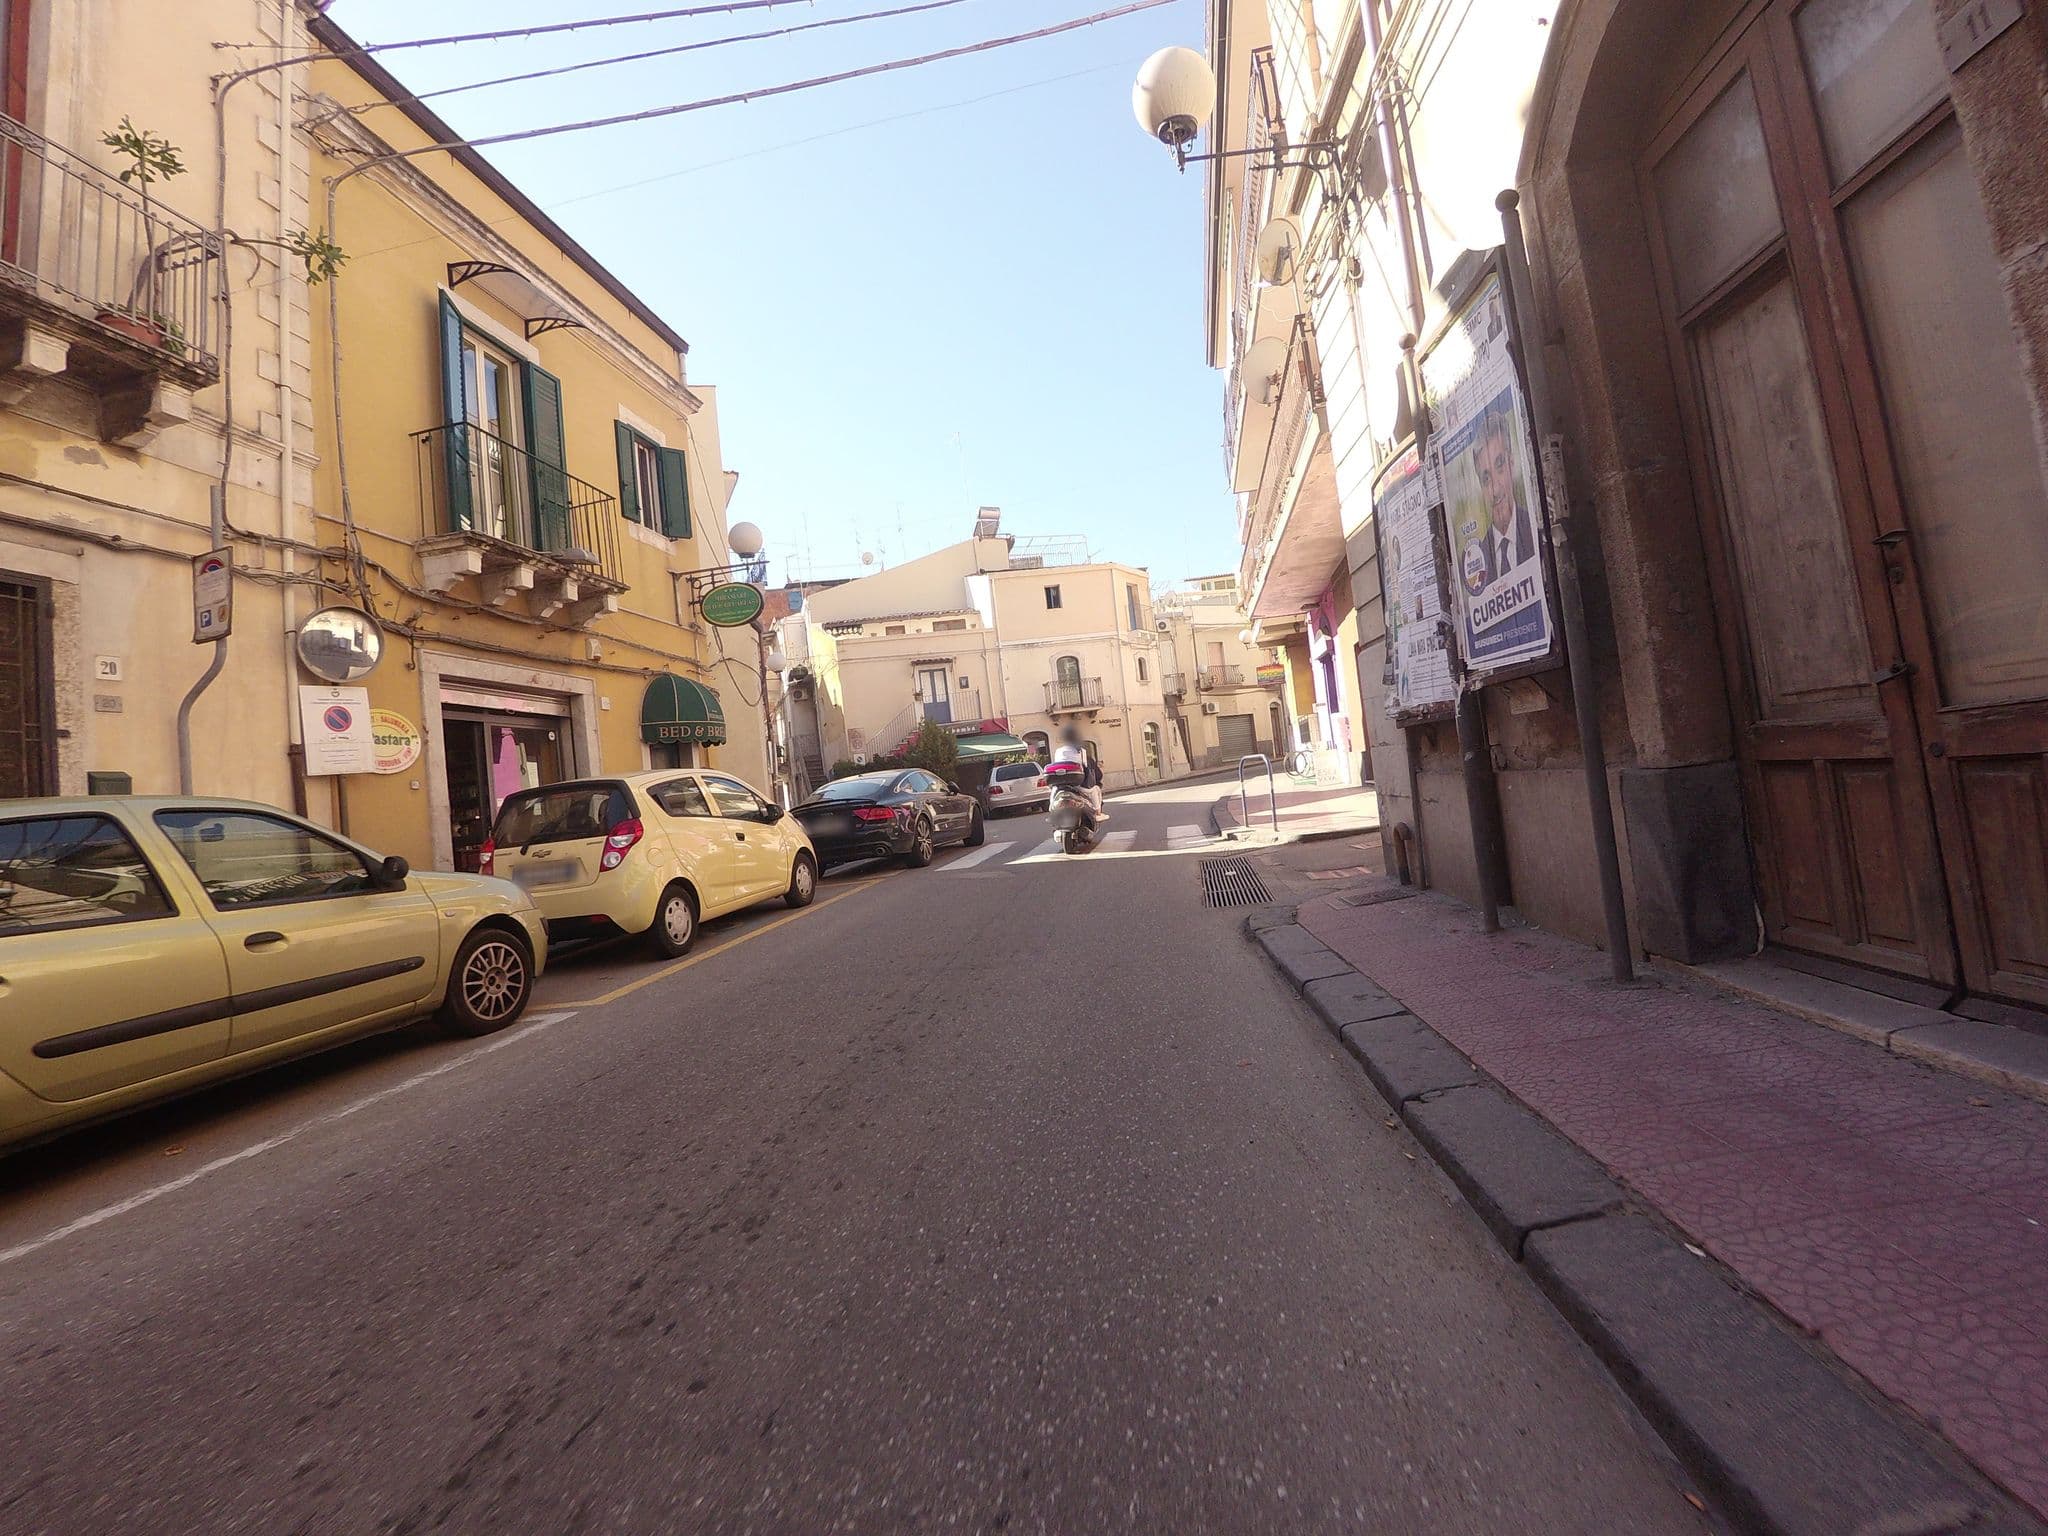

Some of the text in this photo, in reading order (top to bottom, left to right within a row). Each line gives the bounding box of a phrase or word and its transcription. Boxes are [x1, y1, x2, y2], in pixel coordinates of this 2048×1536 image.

[1473, 576, 1536, 627] CURRENTI
[1503, 622, 1538, 640] PRESIDENTE
[100, 660, 118, 676] 20
[659, 726, 691, 738] BED
[694, 725, 704, 737] &
